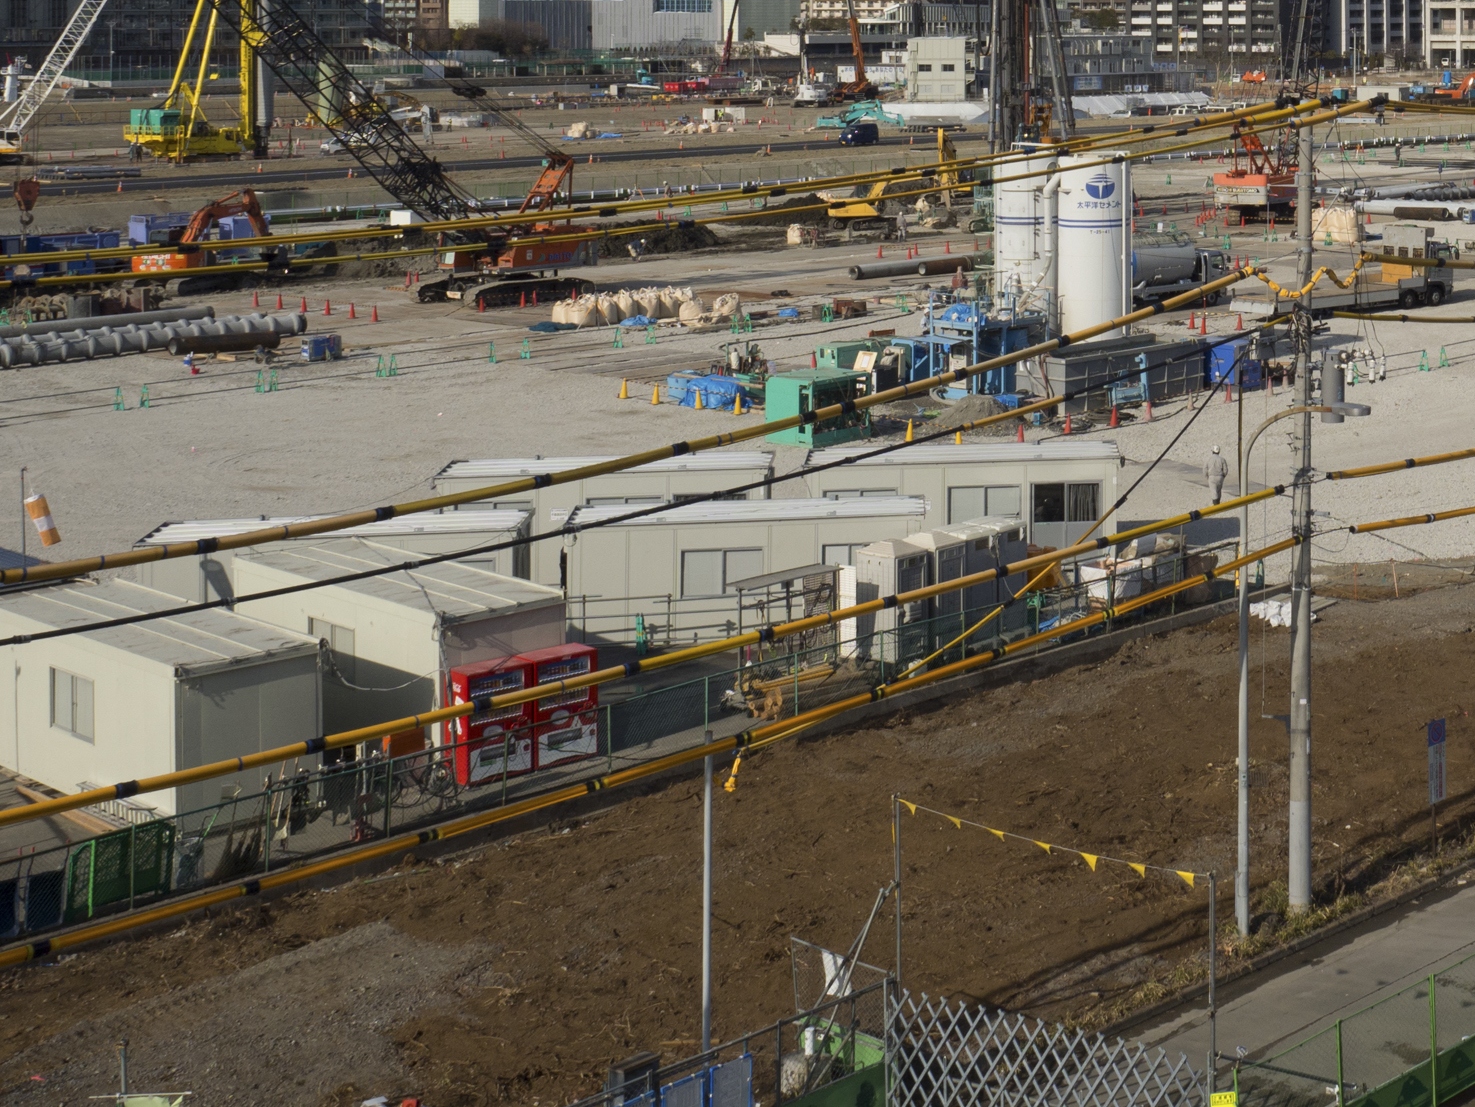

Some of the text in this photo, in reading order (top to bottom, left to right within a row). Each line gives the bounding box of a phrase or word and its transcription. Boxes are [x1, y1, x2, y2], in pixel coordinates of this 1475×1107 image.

[1077, 201, 1121, 209] 太平洋セメント
